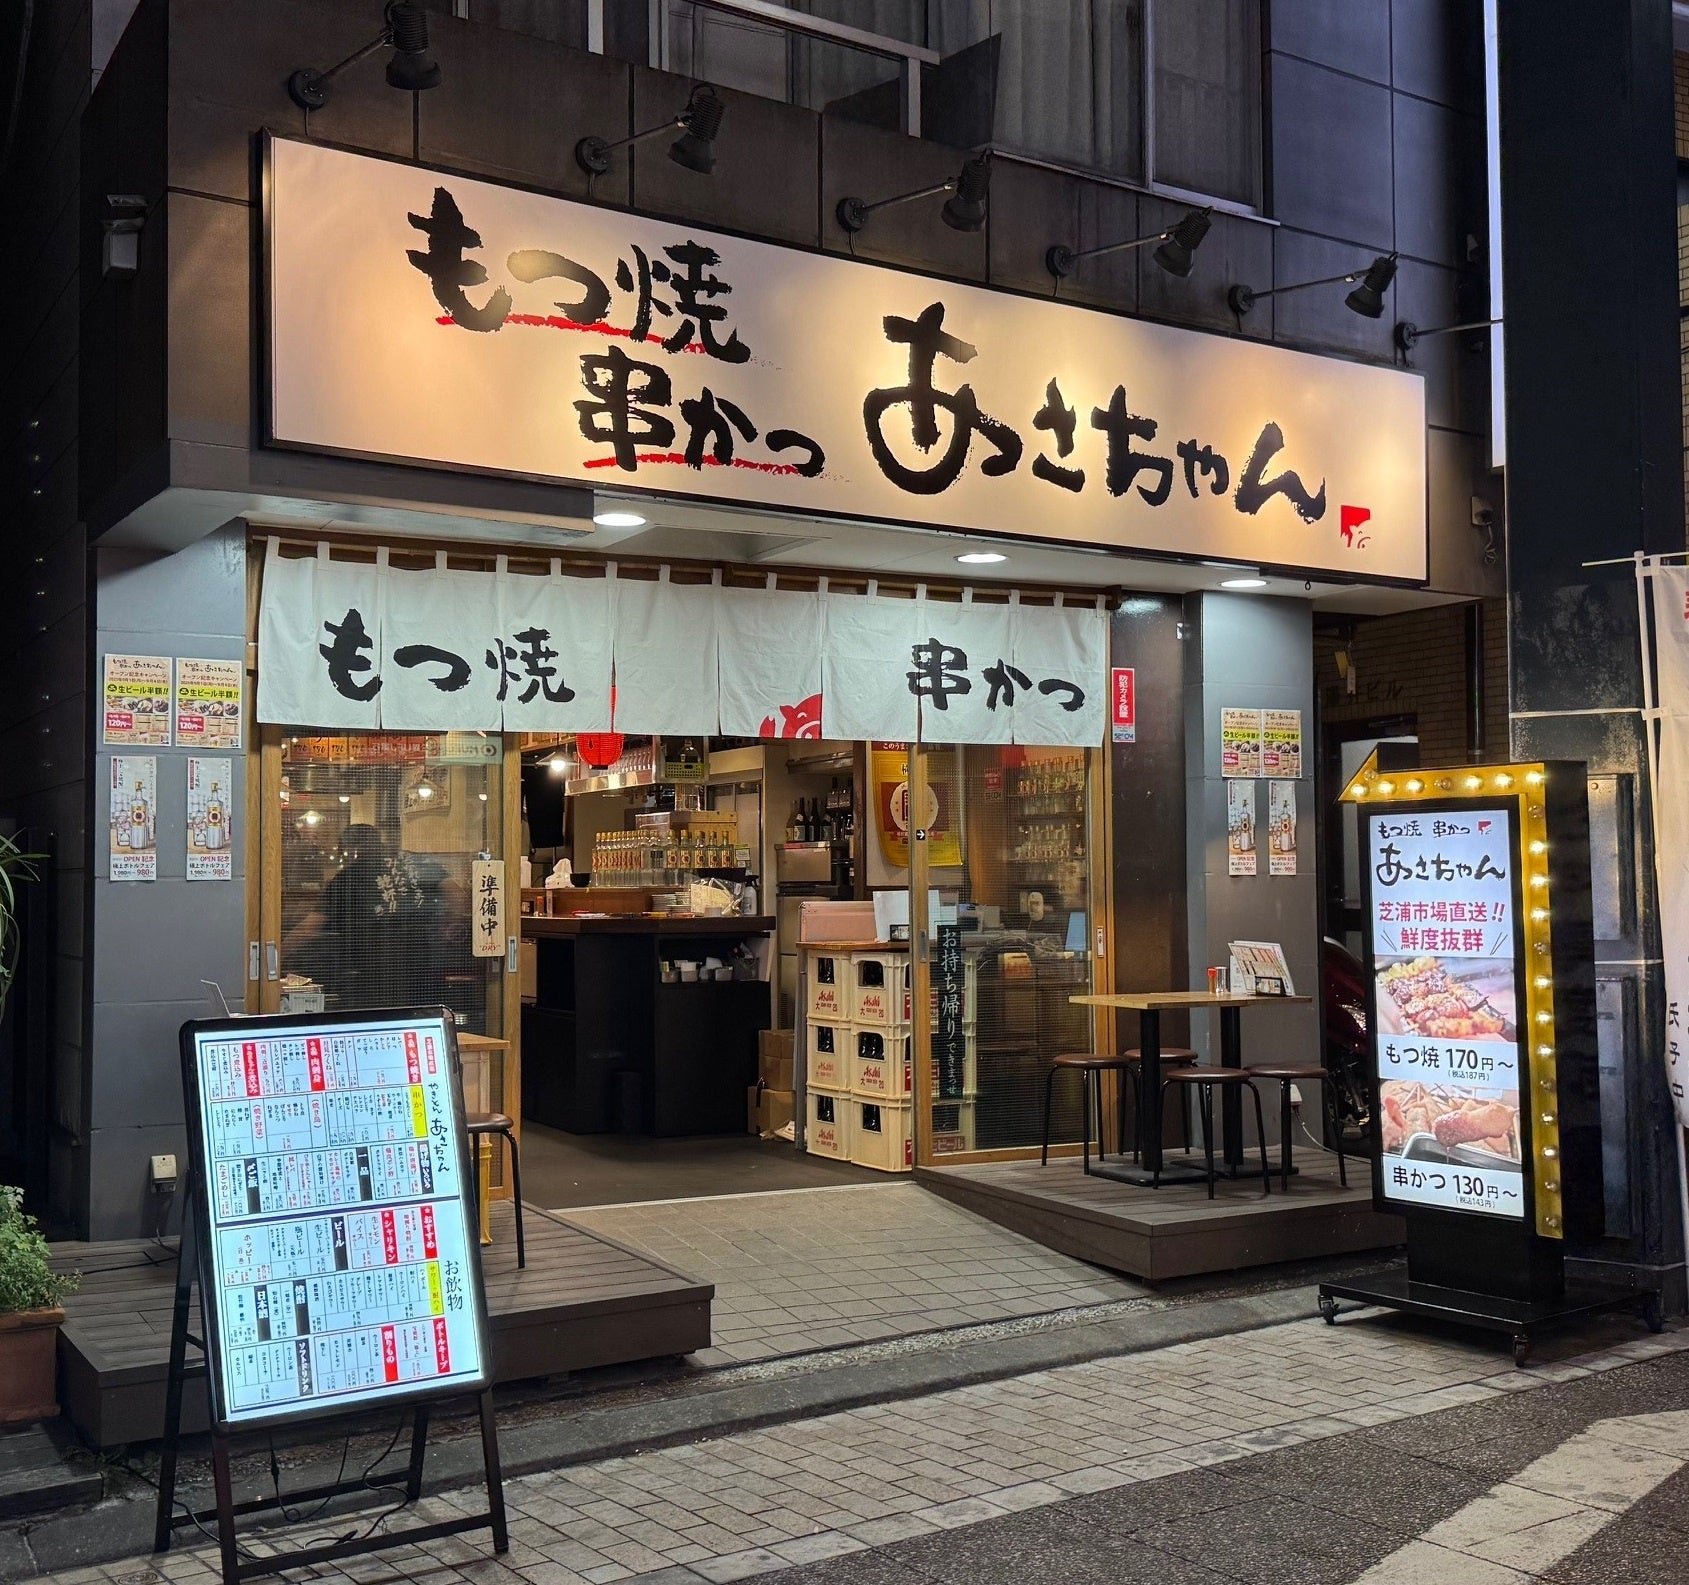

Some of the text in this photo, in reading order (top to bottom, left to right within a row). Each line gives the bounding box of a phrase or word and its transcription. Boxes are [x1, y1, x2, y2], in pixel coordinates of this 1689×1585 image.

[405, 187, 751, 363] もつ焼
[573, 346, 826, 478] 串かつ
[319, 608, 575, 703] もつ焼
[906, 638, 1086, 711] 串かつ
[1378, 820, 1471, 838] もつ焼 串かつ
[479, 874, 500, 936] 準備中
[1378, 901, 1505, 924] 芝浦市場直送!!
[1400, 928, 1484, 952] 鮮度抜群
[818, 990, 834, 1002] Asahi
[863, 994, 881, 1007] Asahi
[941, 928, 961, 1095] お持ち帰りできまっせ
[1386, 1044, 1440, 1068] もつ焼
[863, 1065, 881, 1078] Asahi
[1393, 1167, 1446, 1190] 串かつ
[313, 1223, 324, 1253] 生ビール
[333, 1221, 345, 1247] ビール
[355, 1217, 364, 1239] バイス
[371, 1216, 380, 1245] 生レモン
[383, 1220, 396, 1260] シャリキン
[422, 1216, 435, 1248] おすすめ
[243, 1234, 253, 1264] ホッピー
[443, 1259, 464, 1311] お飲物
[255, 1290, 268, 1319] 日本酒
[383, 1330, 395, 1363] 割りもの
[434, 1321, 448, 1369] ボトルキープ
[298, 1341, 311, 1392] ソフトドリンク
